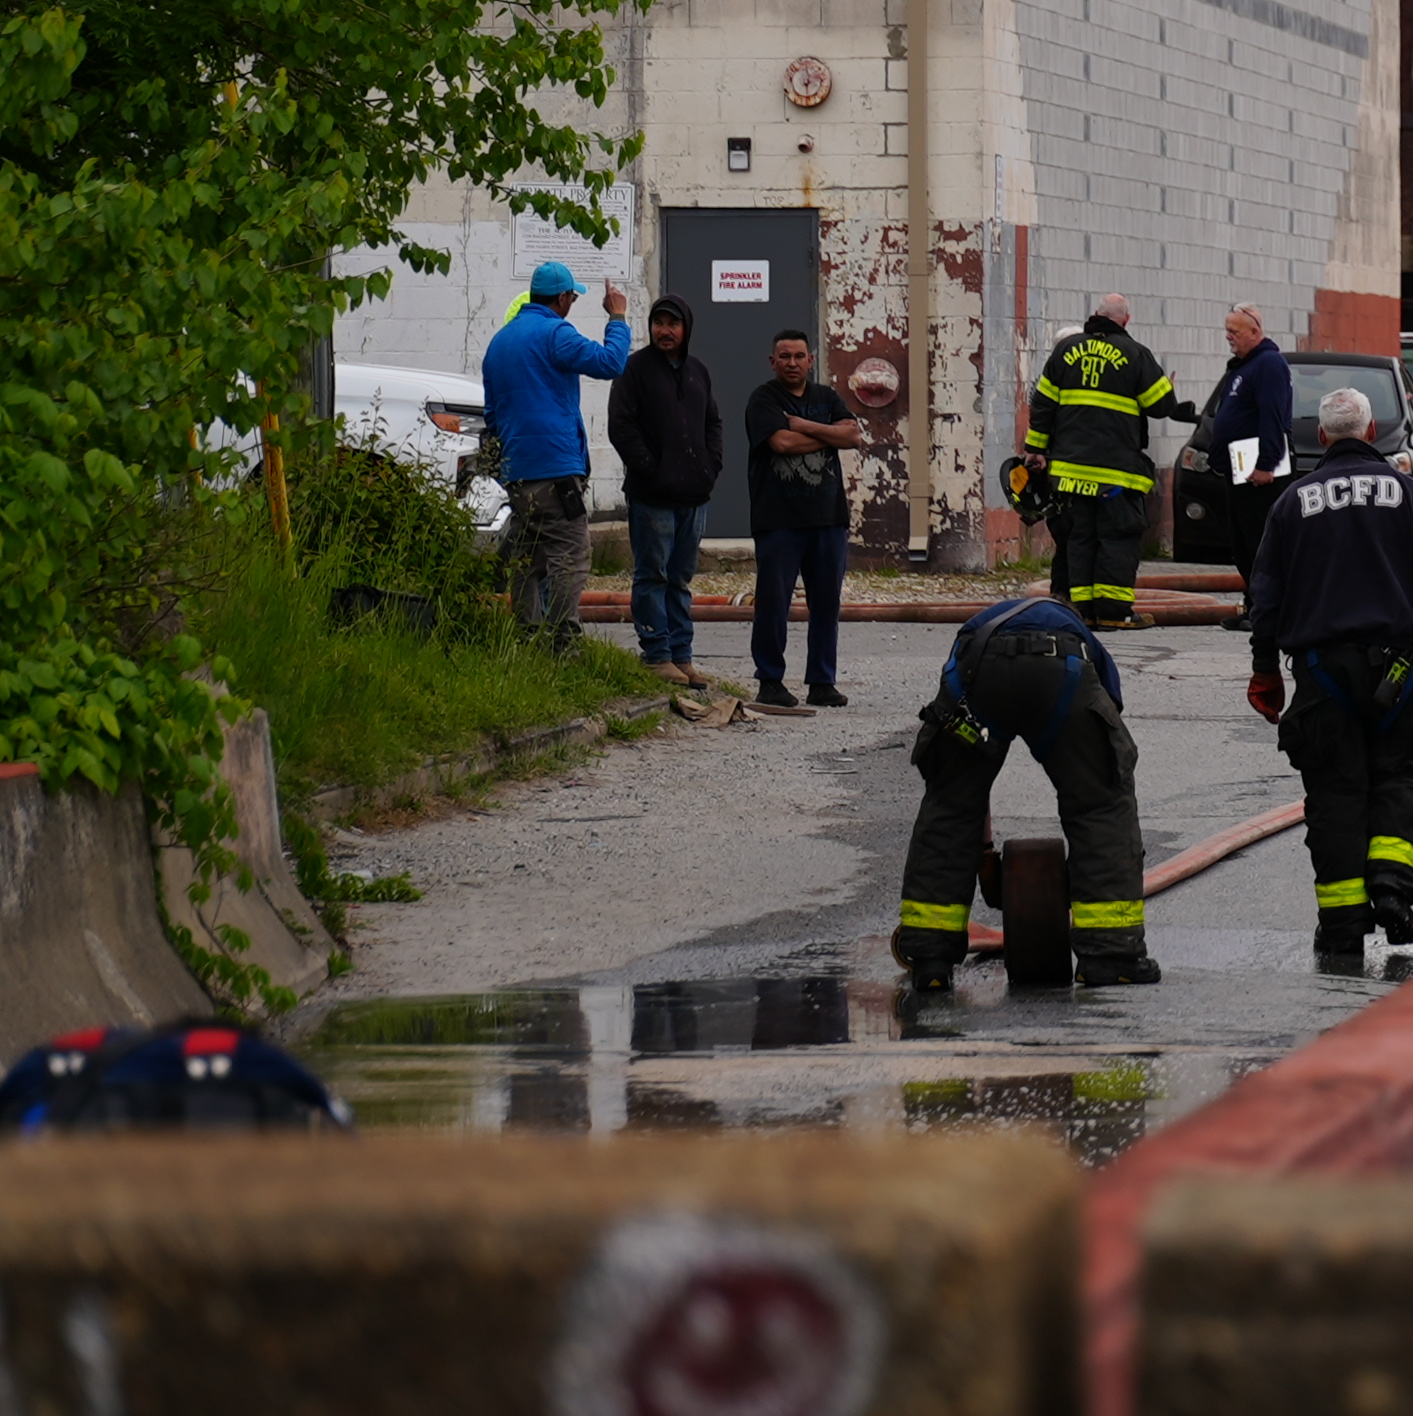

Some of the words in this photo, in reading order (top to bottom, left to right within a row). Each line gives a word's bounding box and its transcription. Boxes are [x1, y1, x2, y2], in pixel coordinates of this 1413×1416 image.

[1063, 339, 1129, 371] BALTIMORE
[1081, 356, 1107, 374] CITY
[1082, 371, 1100, 388] FD
[1057, 477, 1099, 497] DWYER
[1297, 474, 1403, 518] BCFD
